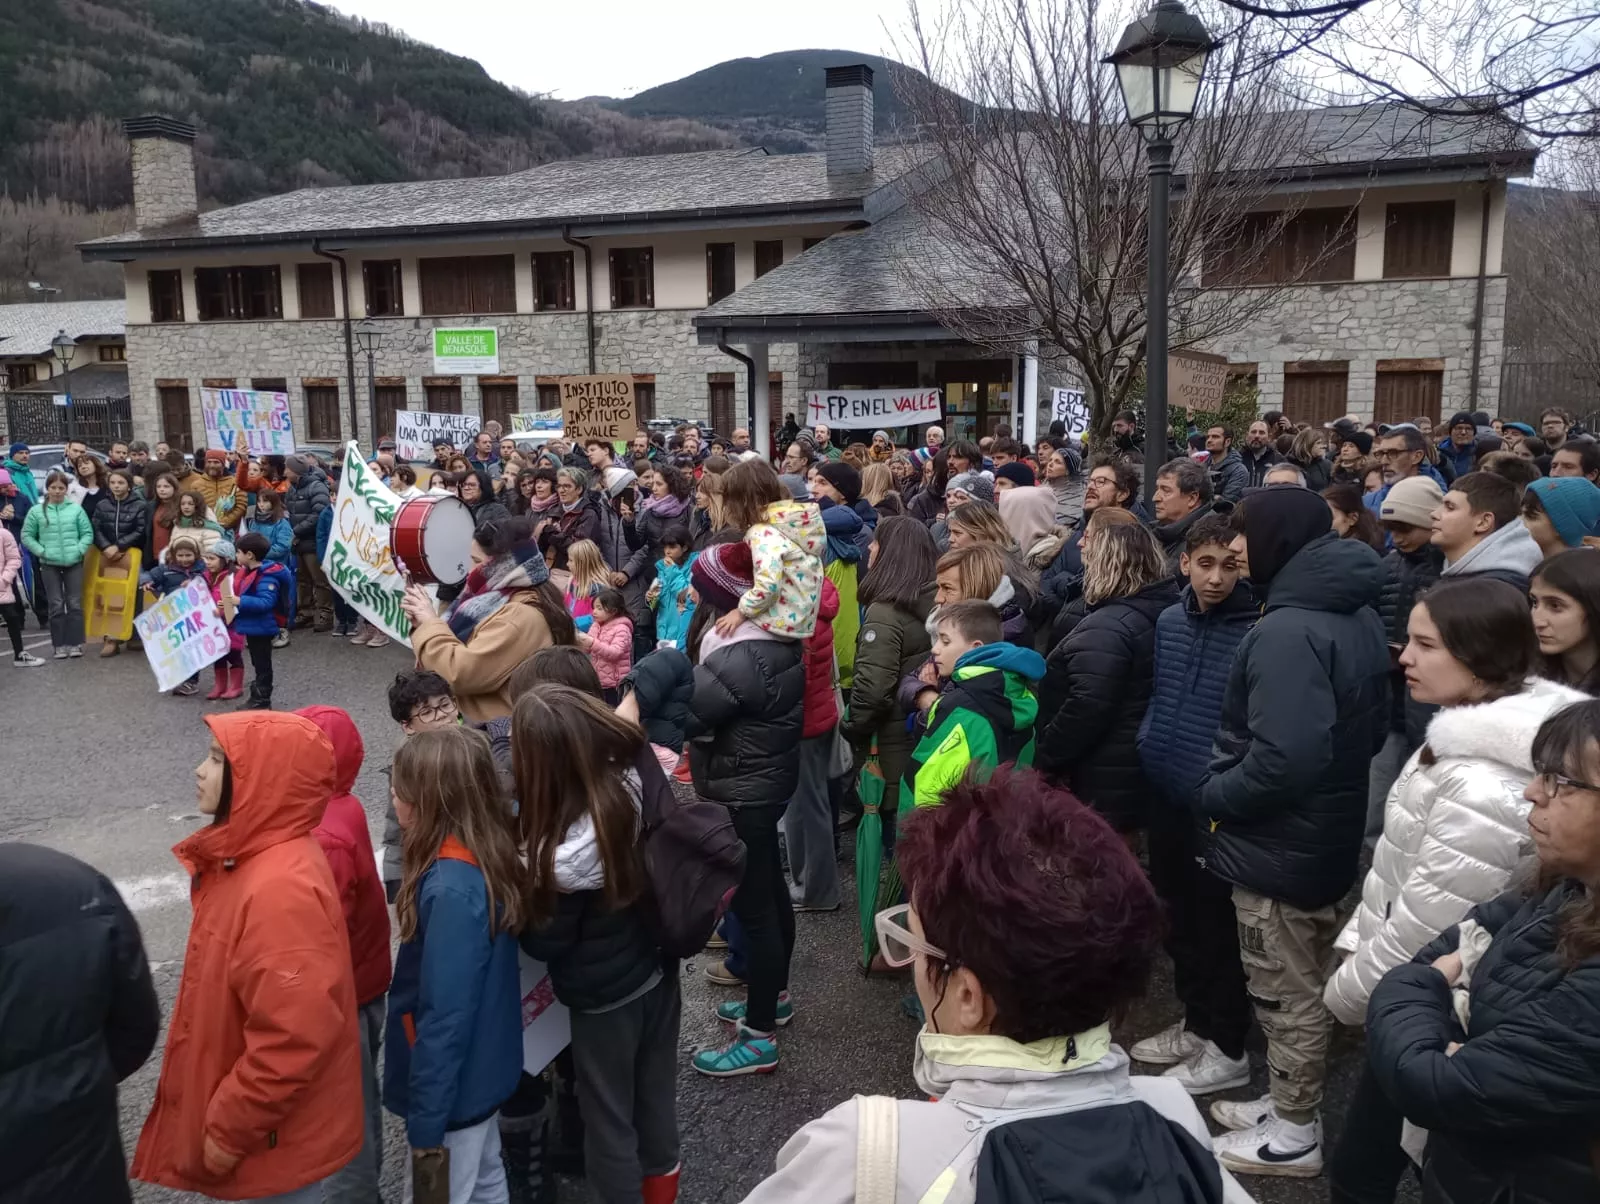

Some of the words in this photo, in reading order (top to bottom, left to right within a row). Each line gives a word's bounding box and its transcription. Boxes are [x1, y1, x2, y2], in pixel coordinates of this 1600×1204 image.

[445, 335, 472, 345] VALLE
[473, 335, 485, 345] DE
[442, 344, 489, 356] BENASQUE
[564, 380, 629, 399] INSTITUTO
[206, 390, 288, 411] JUNTOS
[852, 398, 871, 417] EN
[873, 398, 892, 415] EL
[892, 390, 938, 412] VALLE
[204, 407, 292, 432] HACEMOS
[414, 412, 431, 428] UN
[440, 415, 471, 430] VALLE
[568, 409, 631, 425] INSTITUTO
[399, 425, 418, 443] UNA
[565, 425, 583, 439] DEL
[584, 424, 620, 438] VALLE
[218, 430, 285, 454] VALLE
[159, 609, 208, 656] ESTAR
